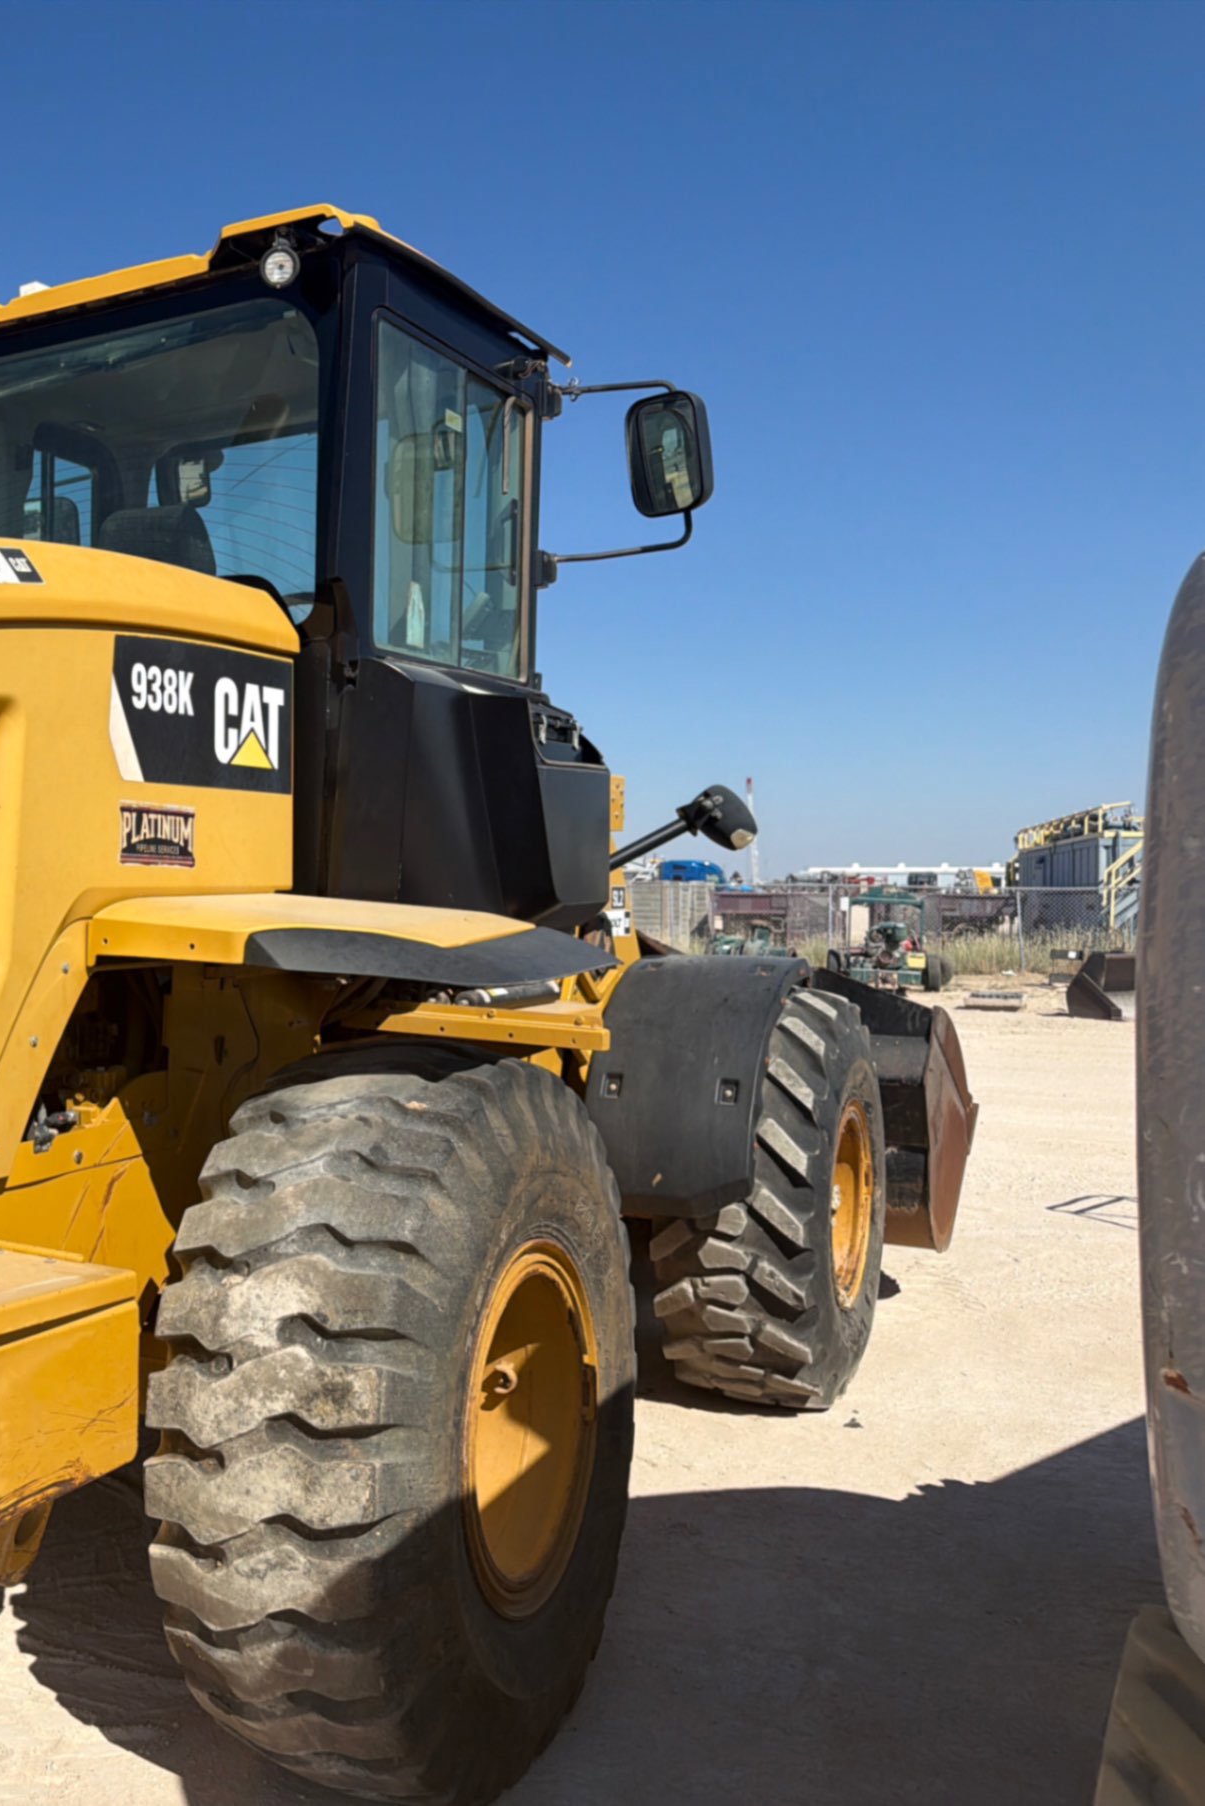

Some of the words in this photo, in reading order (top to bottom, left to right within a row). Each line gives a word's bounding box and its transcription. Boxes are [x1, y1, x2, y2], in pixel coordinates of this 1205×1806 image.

[7, 556, 33, 573] CAT
[131, 662, 195, 717] 938K
[214, 676, 285, 770] CAT
[121, 810, 193, 852] PLATINUM
